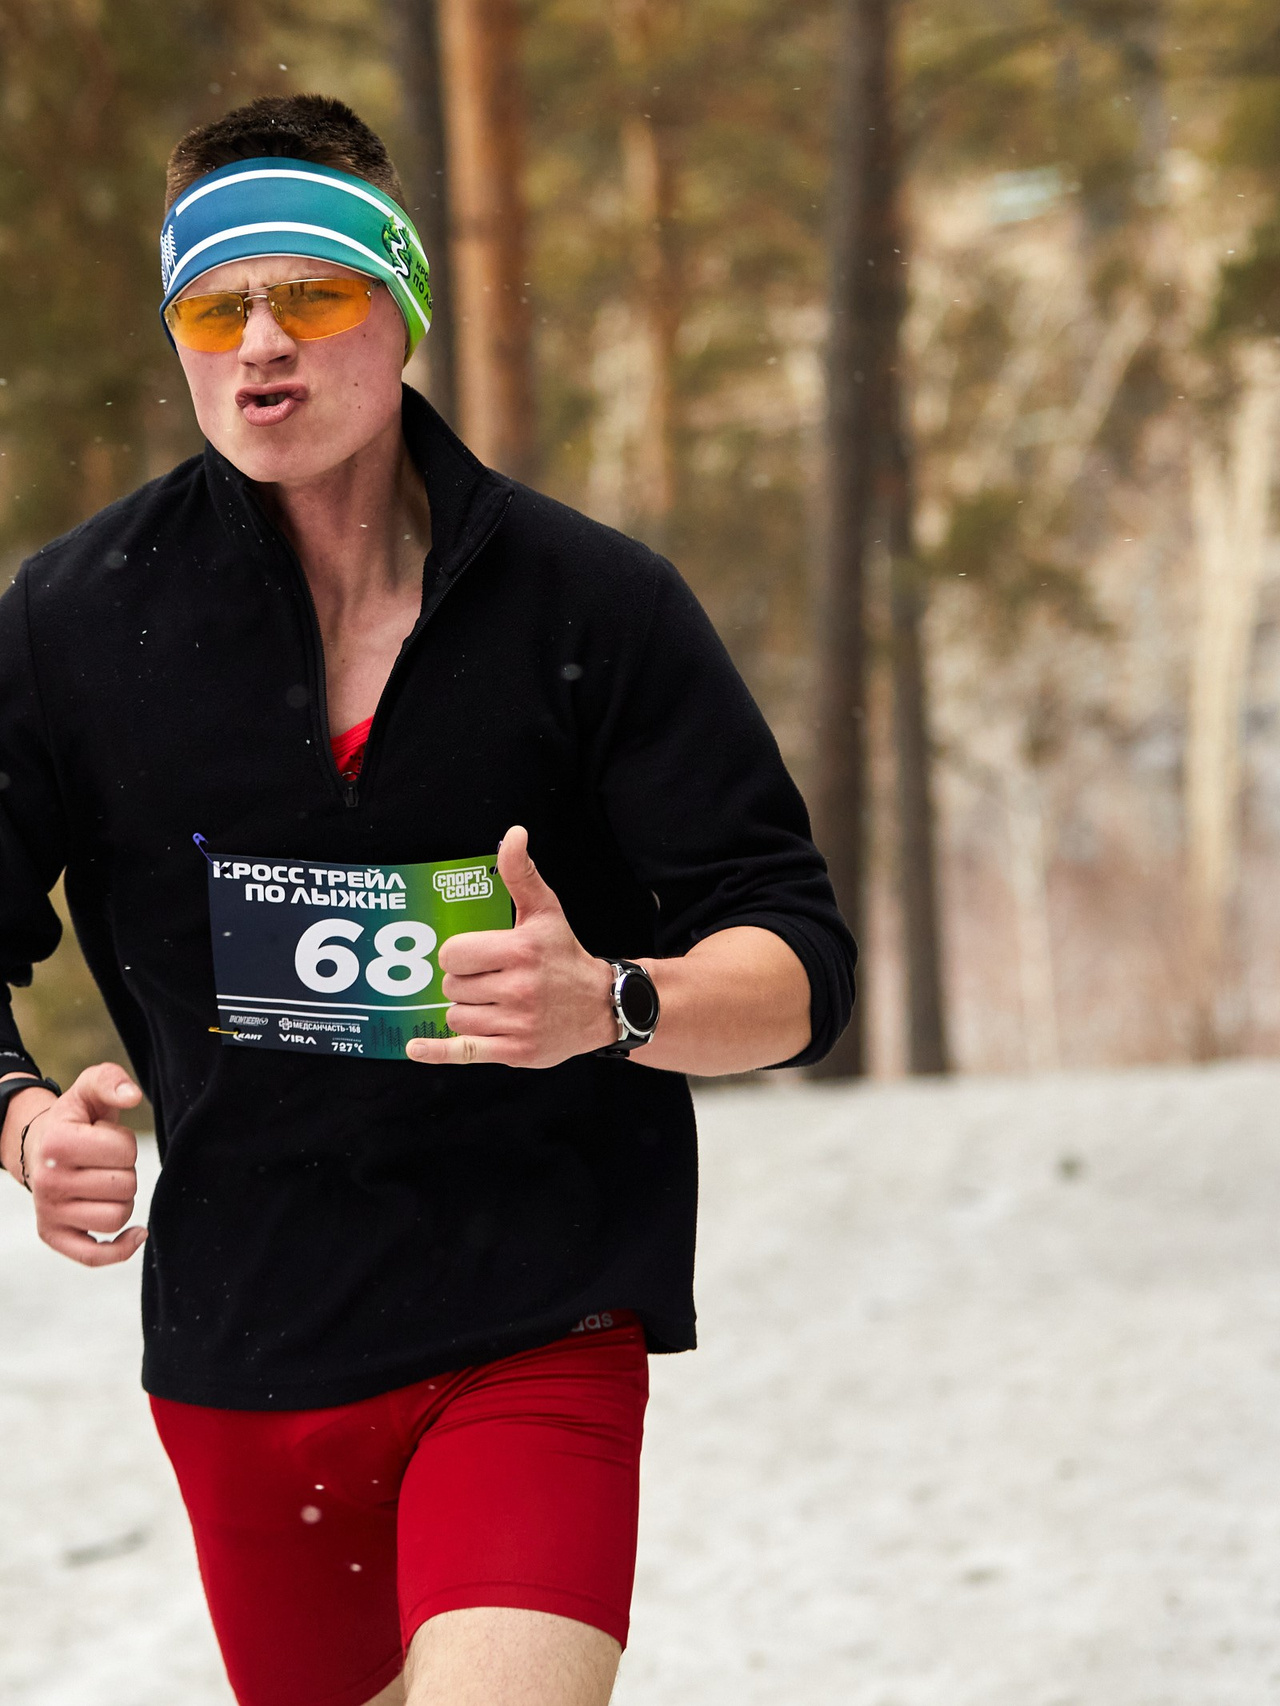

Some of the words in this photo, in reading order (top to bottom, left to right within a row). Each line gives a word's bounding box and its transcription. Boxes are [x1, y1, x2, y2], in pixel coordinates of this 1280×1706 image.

[413, 272, 424, 294] ПО
[213, 861, 306, 885] КРОСС
[308, 868, 407, 891] ТРЕЙЛ
[437, 870, 482, 888] СПОРТ
[245, 883, 286, 904] ПО
[290, 886, 407, 910] ЛЫЖНЕ
[446, 882, 489, 899] СОЮЗ
[294, 918, 438, 998] 68
[278, 1033, 317, 1045] VIRA
